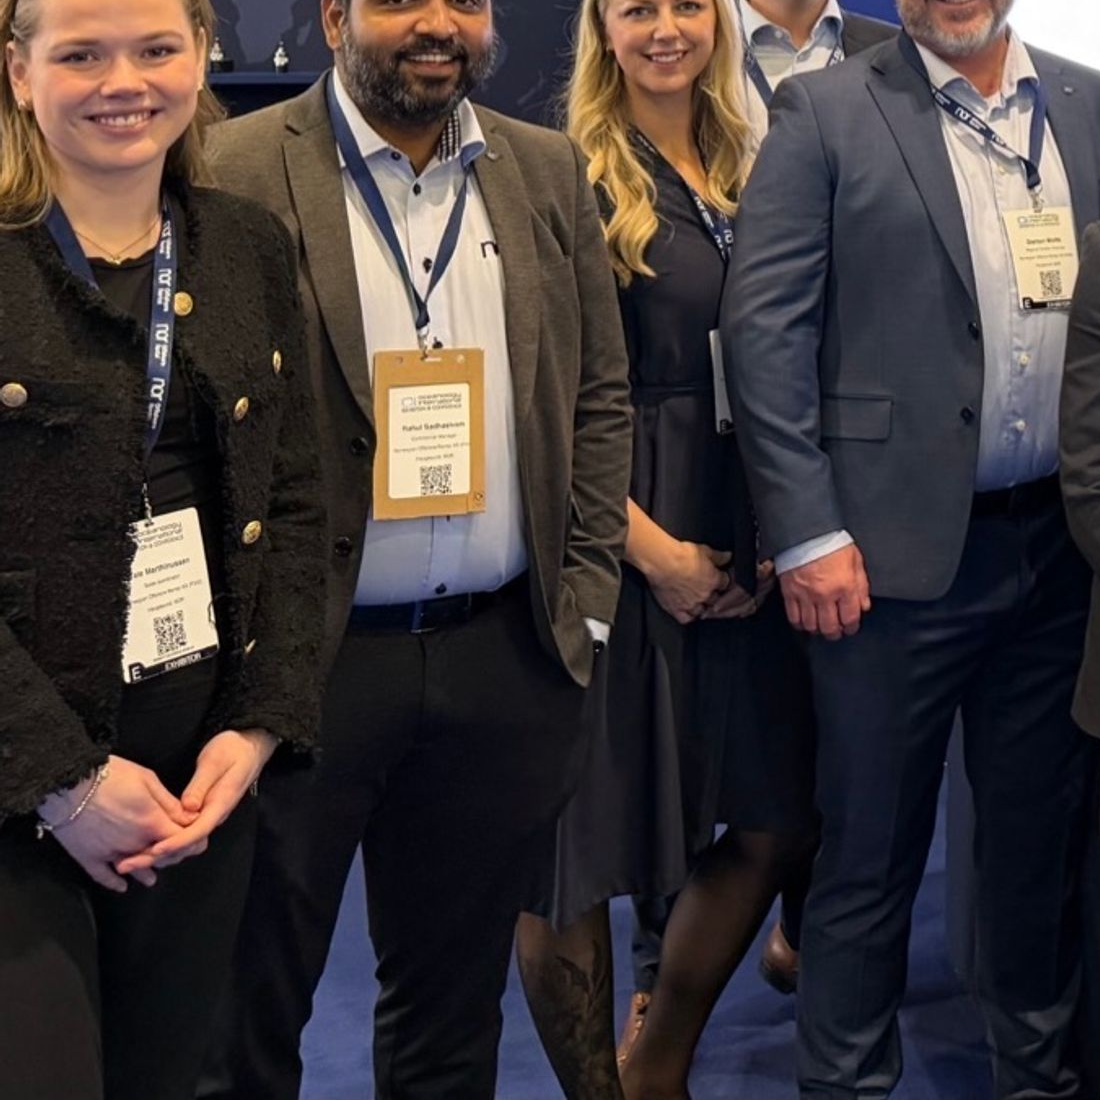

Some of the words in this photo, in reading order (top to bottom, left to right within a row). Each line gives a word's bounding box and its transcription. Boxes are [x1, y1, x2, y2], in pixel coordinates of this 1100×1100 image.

[158, 268, 172, 289] nor
[155, 323, 169, 345] nor
[150, 378, 166, 401] nor
[132, 666, 142, 681] E
